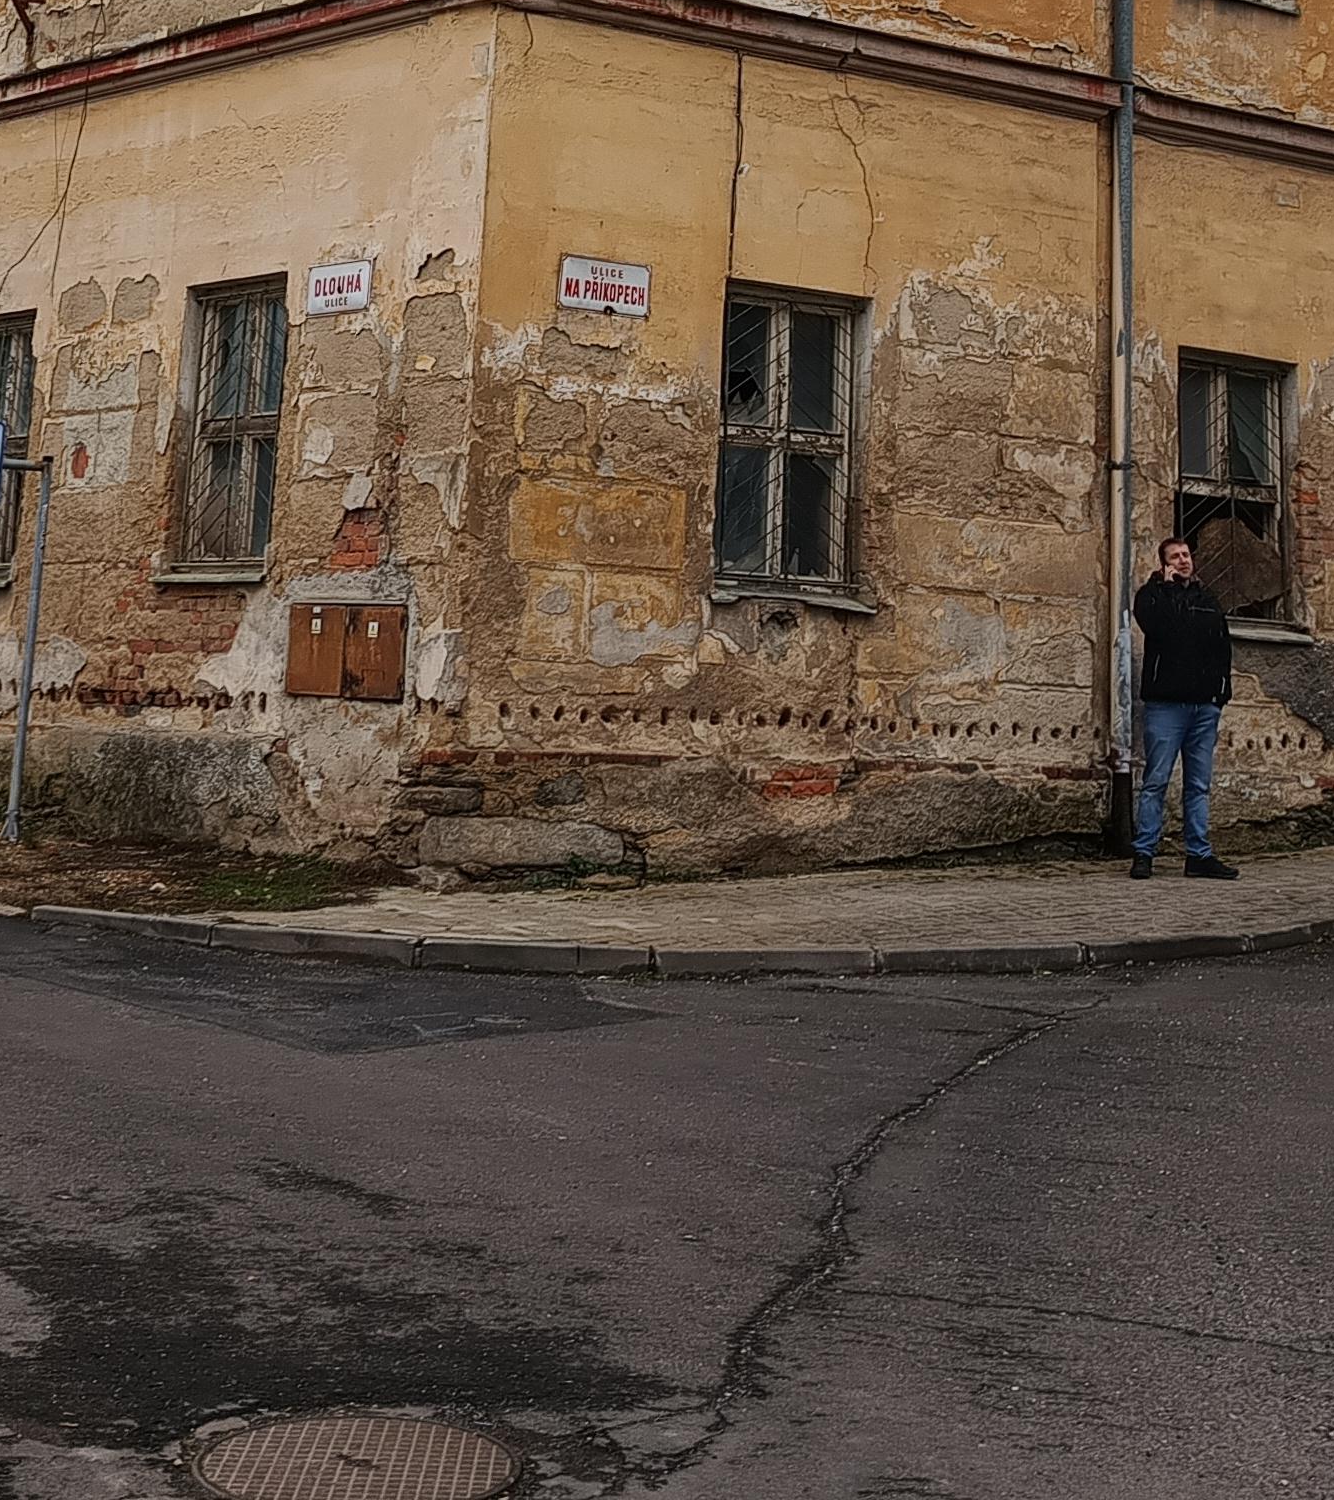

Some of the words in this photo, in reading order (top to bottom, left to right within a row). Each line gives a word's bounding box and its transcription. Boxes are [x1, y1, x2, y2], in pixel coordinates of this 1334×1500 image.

[591, 266, 624, 279] ULICE
[315, 269, 362, 297] DLOUHÁ
[564, 277, 579, 298] NA
[583, 276, 645, 306] PŘÍKOPECH
[324, 297, 348, 307] ULICE
